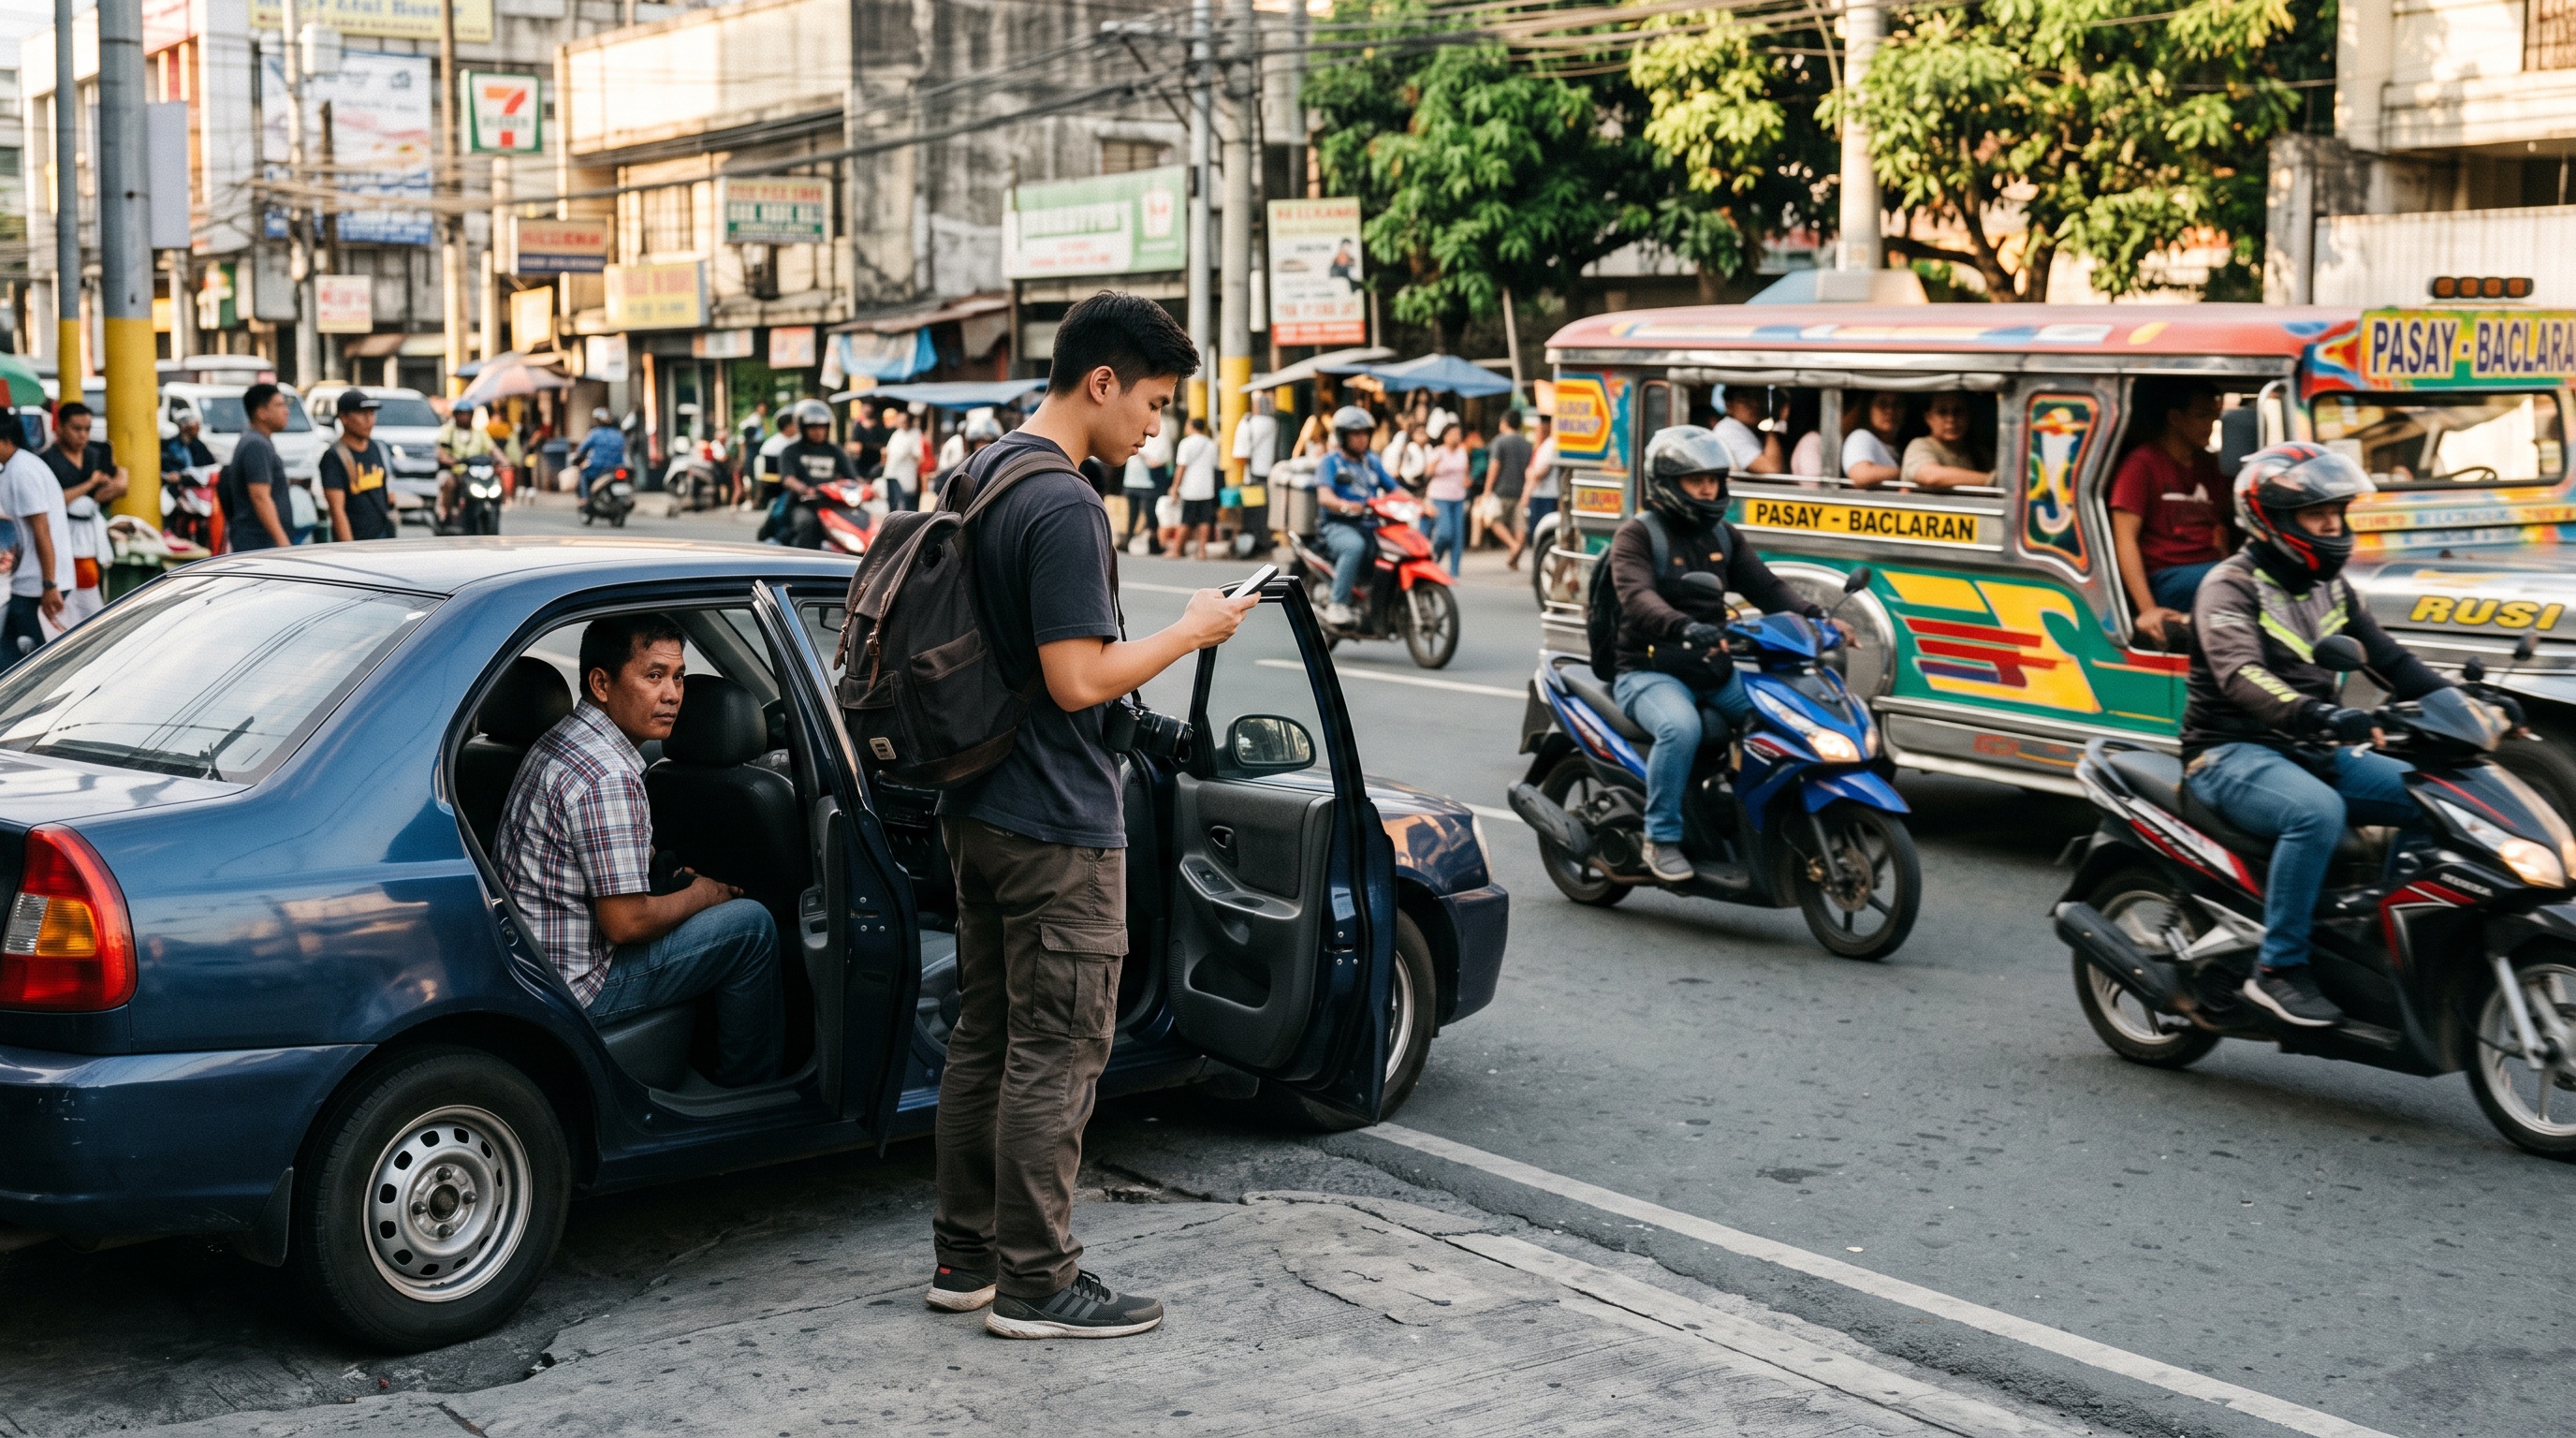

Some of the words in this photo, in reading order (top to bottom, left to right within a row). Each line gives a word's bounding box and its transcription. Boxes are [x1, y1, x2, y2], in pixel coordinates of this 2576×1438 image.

[2372, 321, 2457, 374] PASAY
[2462, 343, 2468, 354] -
[1756, 503, 1823, 528] PASAY
[1849, 510, 1975, 540] BACLARAN
[2409, 594, 2566, 631] RUSI
